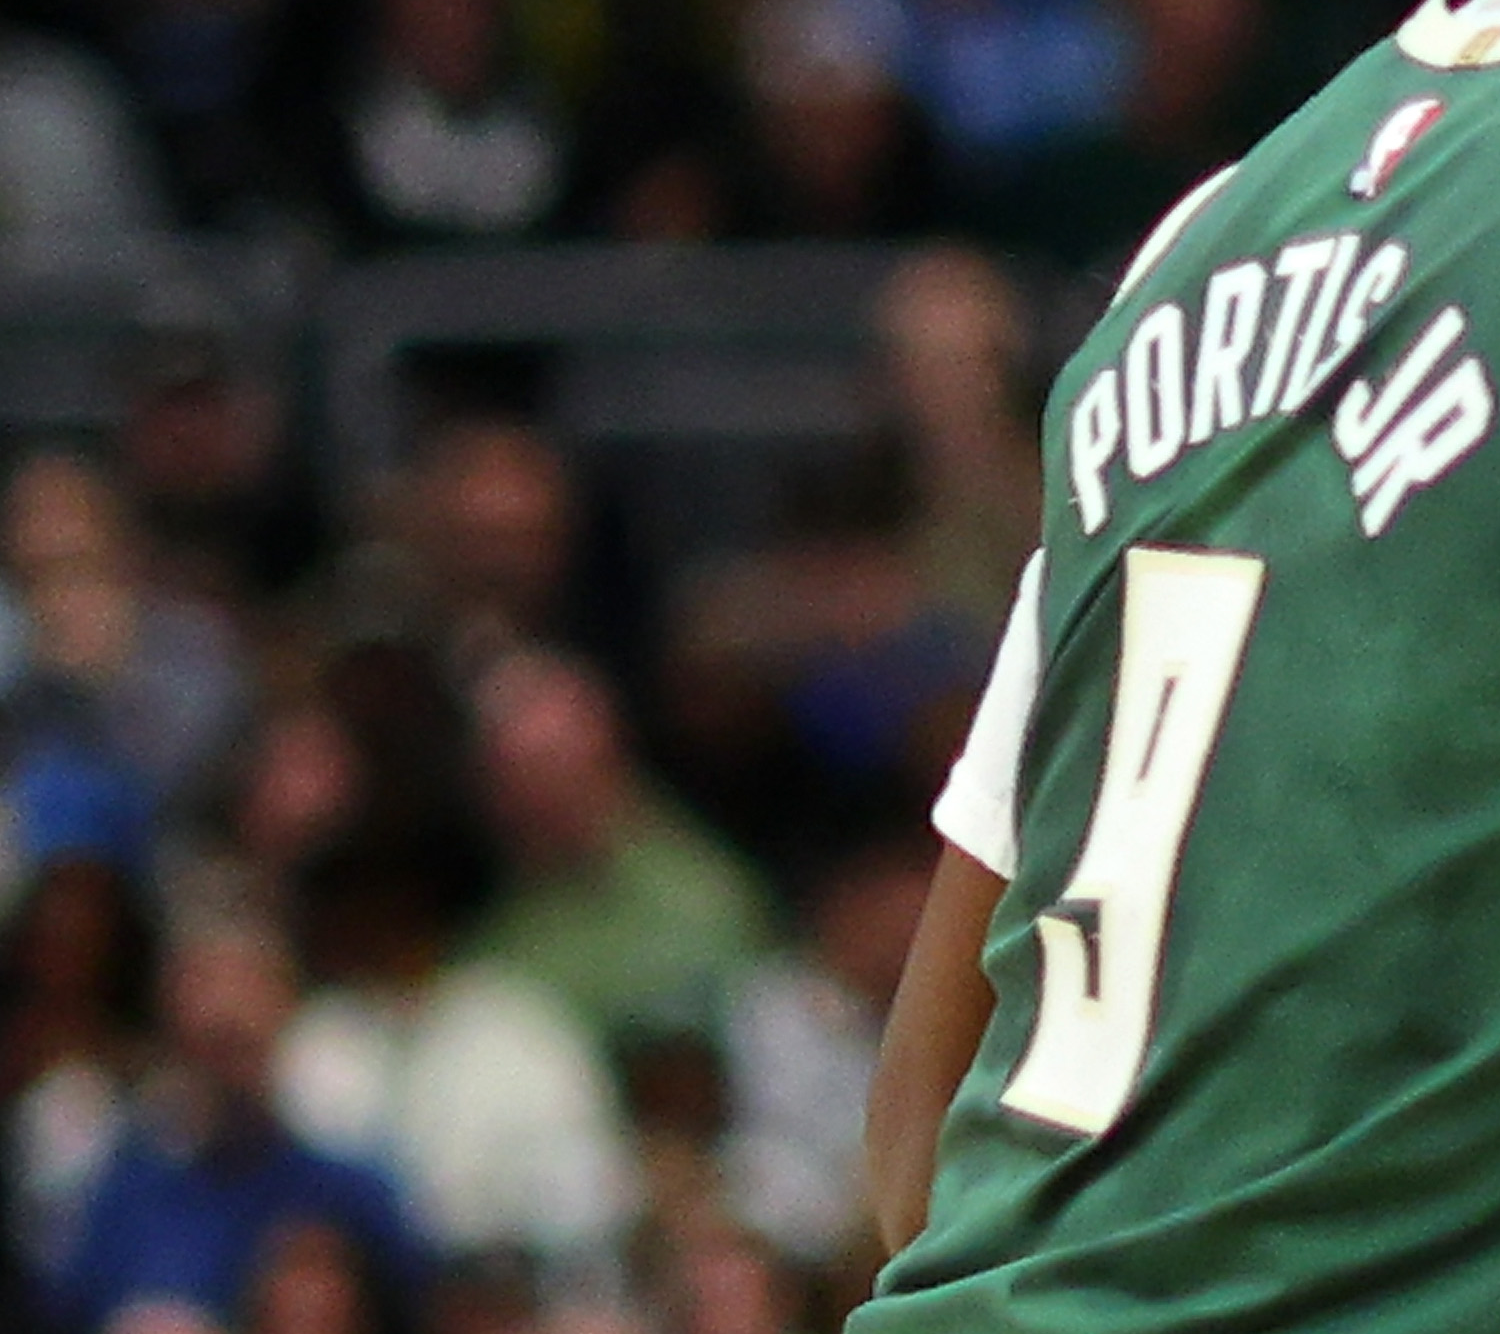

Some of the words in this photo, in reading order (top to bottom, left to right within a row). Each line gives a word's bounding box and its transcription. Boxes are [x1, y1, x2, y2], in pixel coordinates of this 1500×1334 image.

[1067, 230, 1410, 536] PORTIS
[1331, 305, 1496, 539] JR
[999, 542, 1268, 1139] 9
